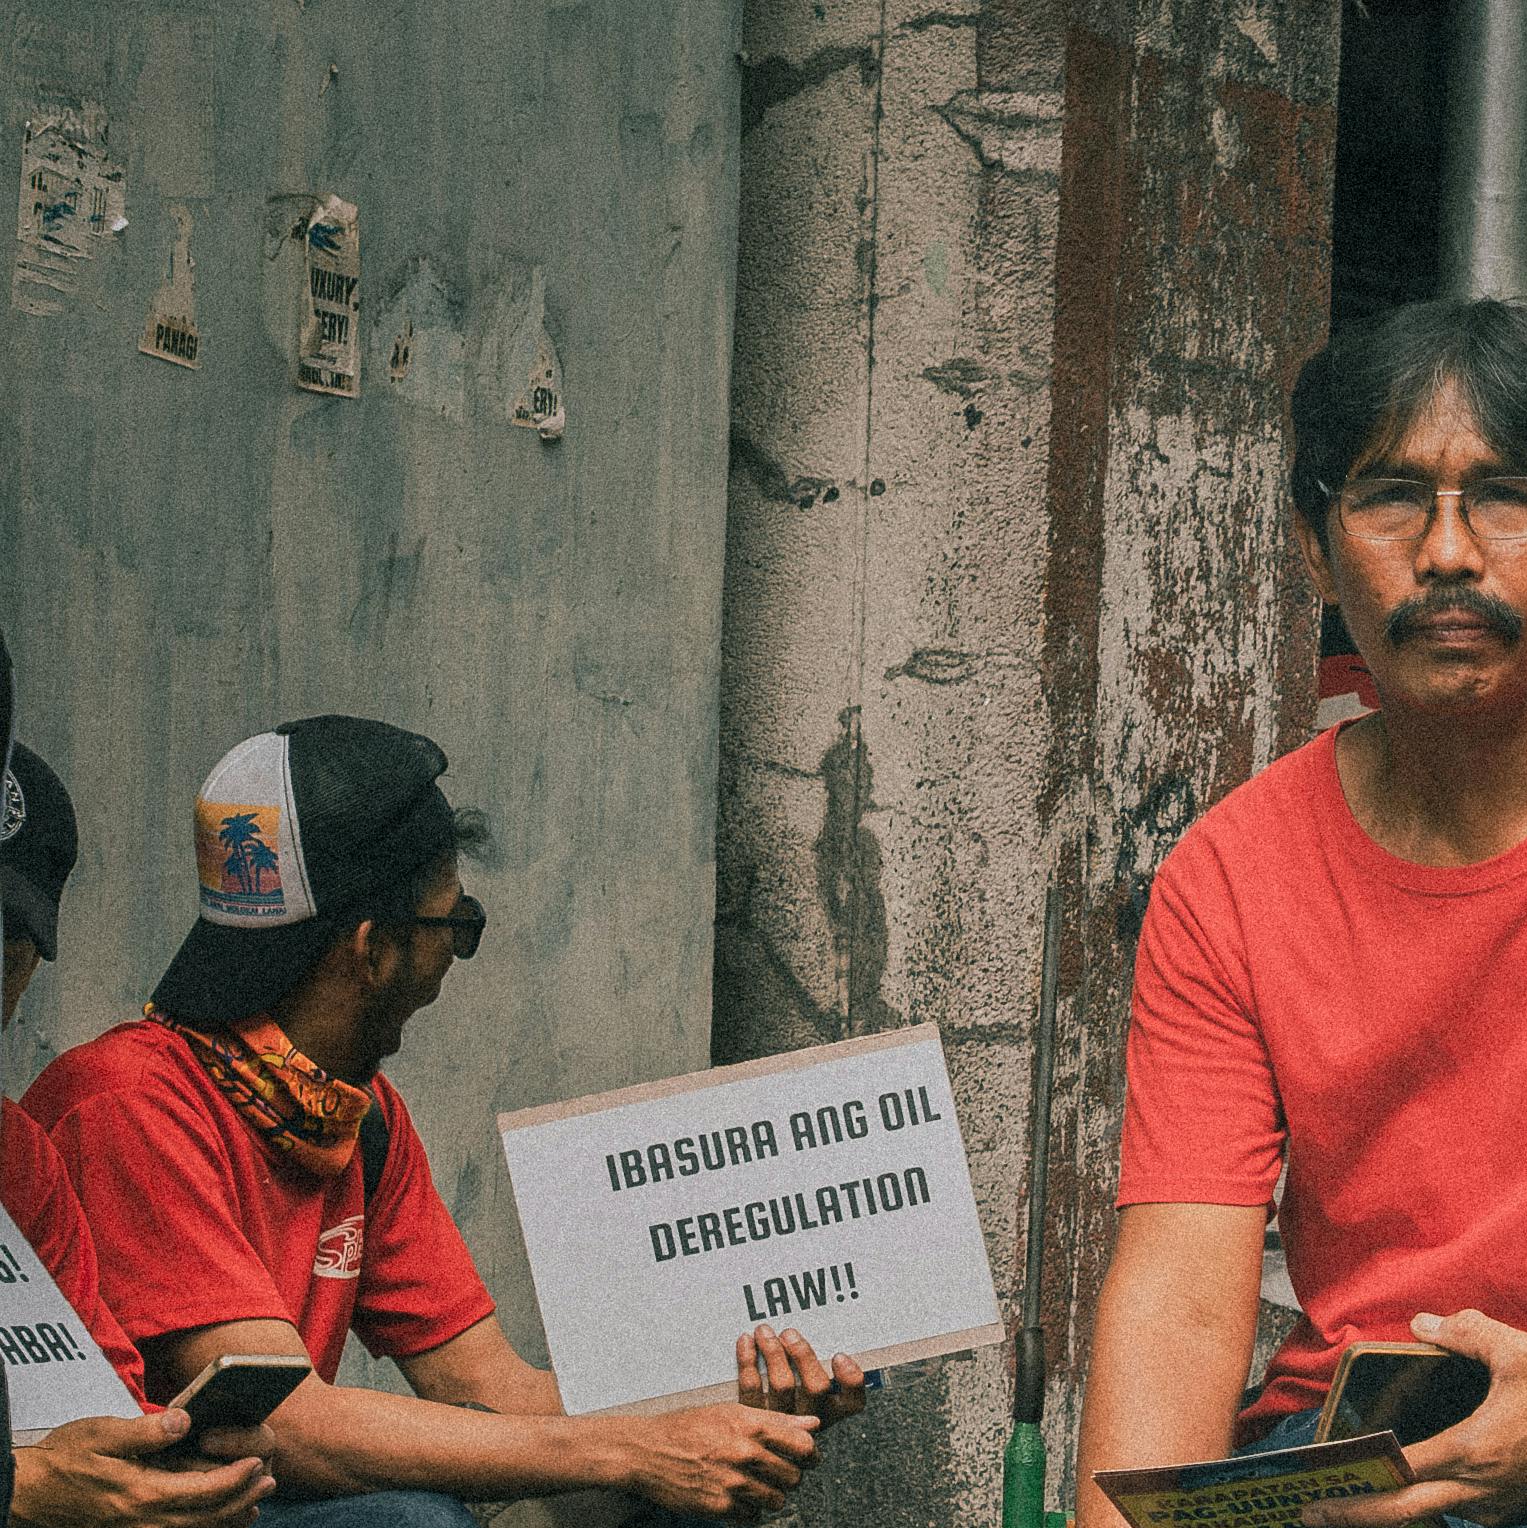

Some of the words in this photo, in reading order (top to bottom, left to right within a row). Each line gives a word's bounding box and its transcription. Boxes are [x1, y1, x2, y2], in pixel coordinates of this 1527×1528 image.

[314, 308, 349, 345] ERY!
[606, 1119, 778, 1191] IBASURA
[790, 1100, 868, 1152] ANG
[878, 1086, 941, 1131] OIL
[648, 1166, 932, 1262] DEREGULATION
[743, 1262, 860, 1322] LAW!!
